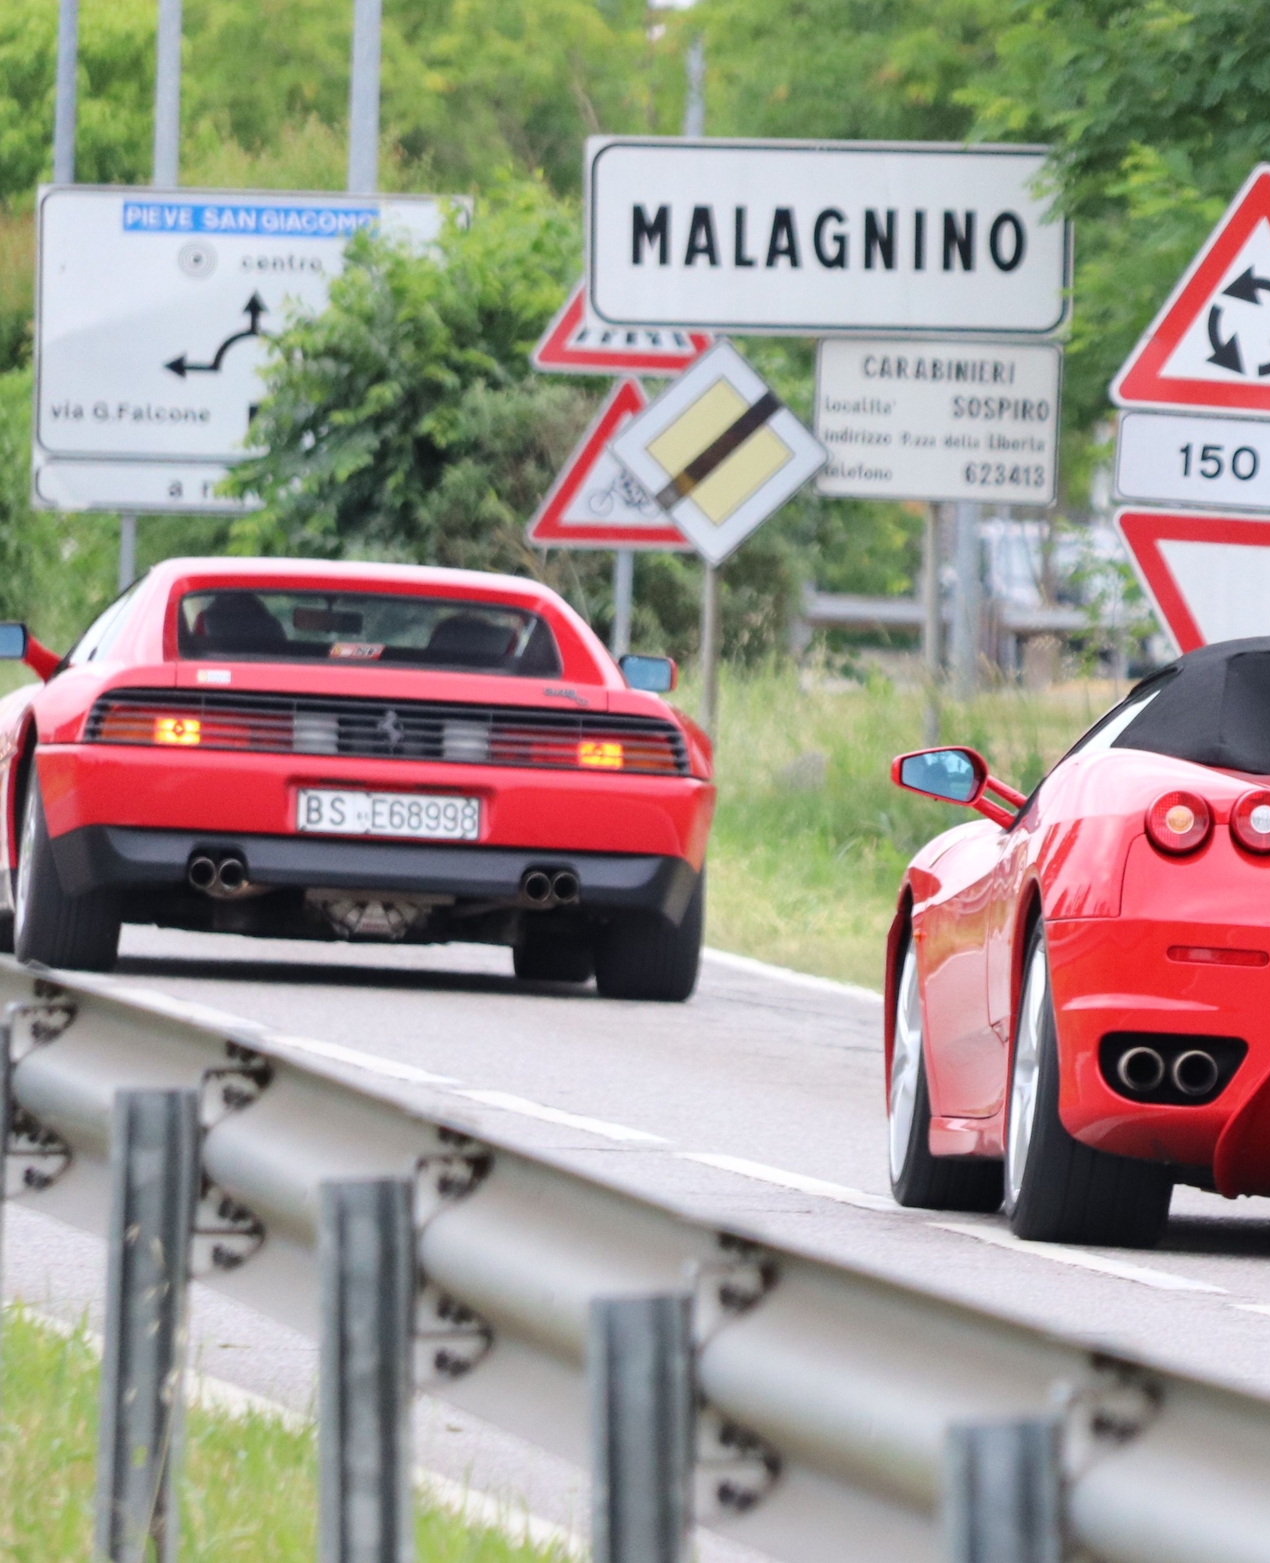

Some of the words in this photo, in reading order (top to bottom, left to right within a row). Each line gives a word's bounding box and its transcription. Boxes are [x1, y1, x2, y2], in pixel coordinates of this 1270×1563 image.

[126, 205, 193, 227] PIEVE
[203, 207, 257, 230] SAN
[632, 205, 1026, 272] MALAGNINO
[242, 253, 322, 272] centro
[863, 356, 1016, 384] CARABINIERI
[52, 402, 84, 420] via
[952, 396, 1050, 422] SOSPIRO
[825, 427, 892, 445] indirizzo
[944, 433, 980, 449] della
[824, 462, 893, 480] telefono
[965, 462, 1046, 487] 623413
[1180, 444, 1258, 480] 150
[306, 795, 346, 826] BS
[371, 799, 477, 833] E68998
